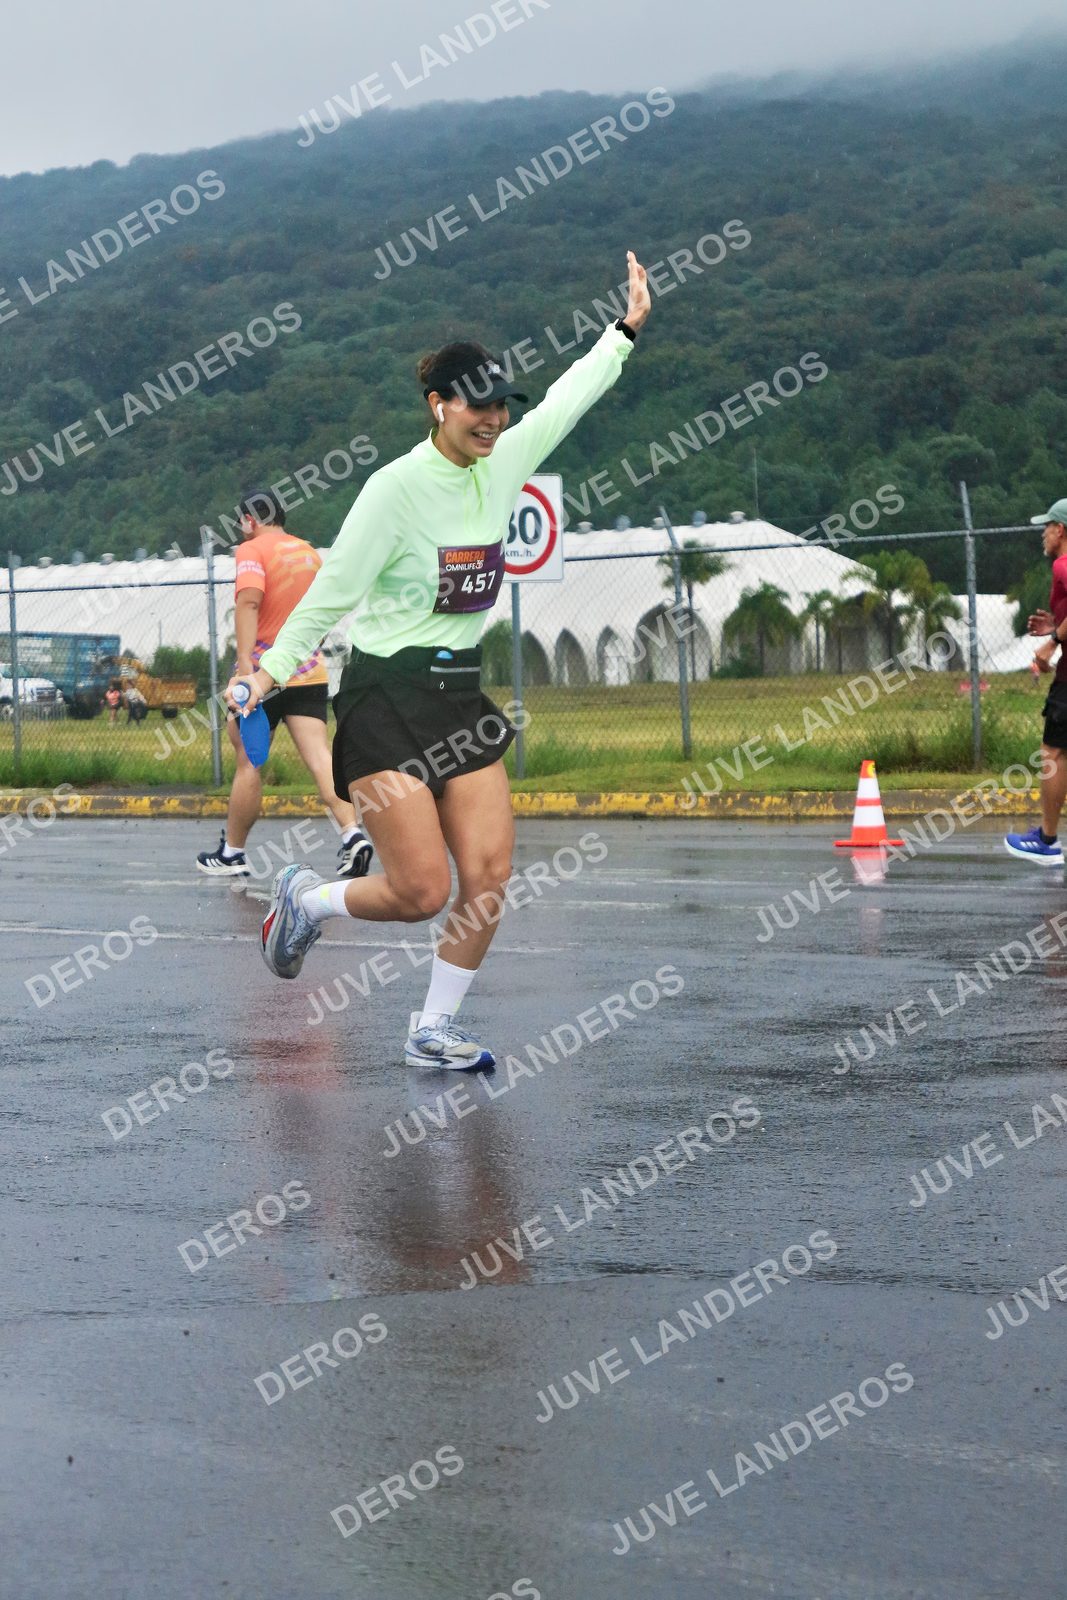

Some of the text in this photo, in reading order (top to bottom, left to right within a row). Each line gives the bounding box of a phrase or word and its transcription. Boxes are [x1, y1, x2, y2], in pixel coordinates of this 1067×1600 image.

[445, 550, 486, 563] CARRERA
[445, 562, 476, 572] OMNILIFE
[461, 569, 496, 594] 457
